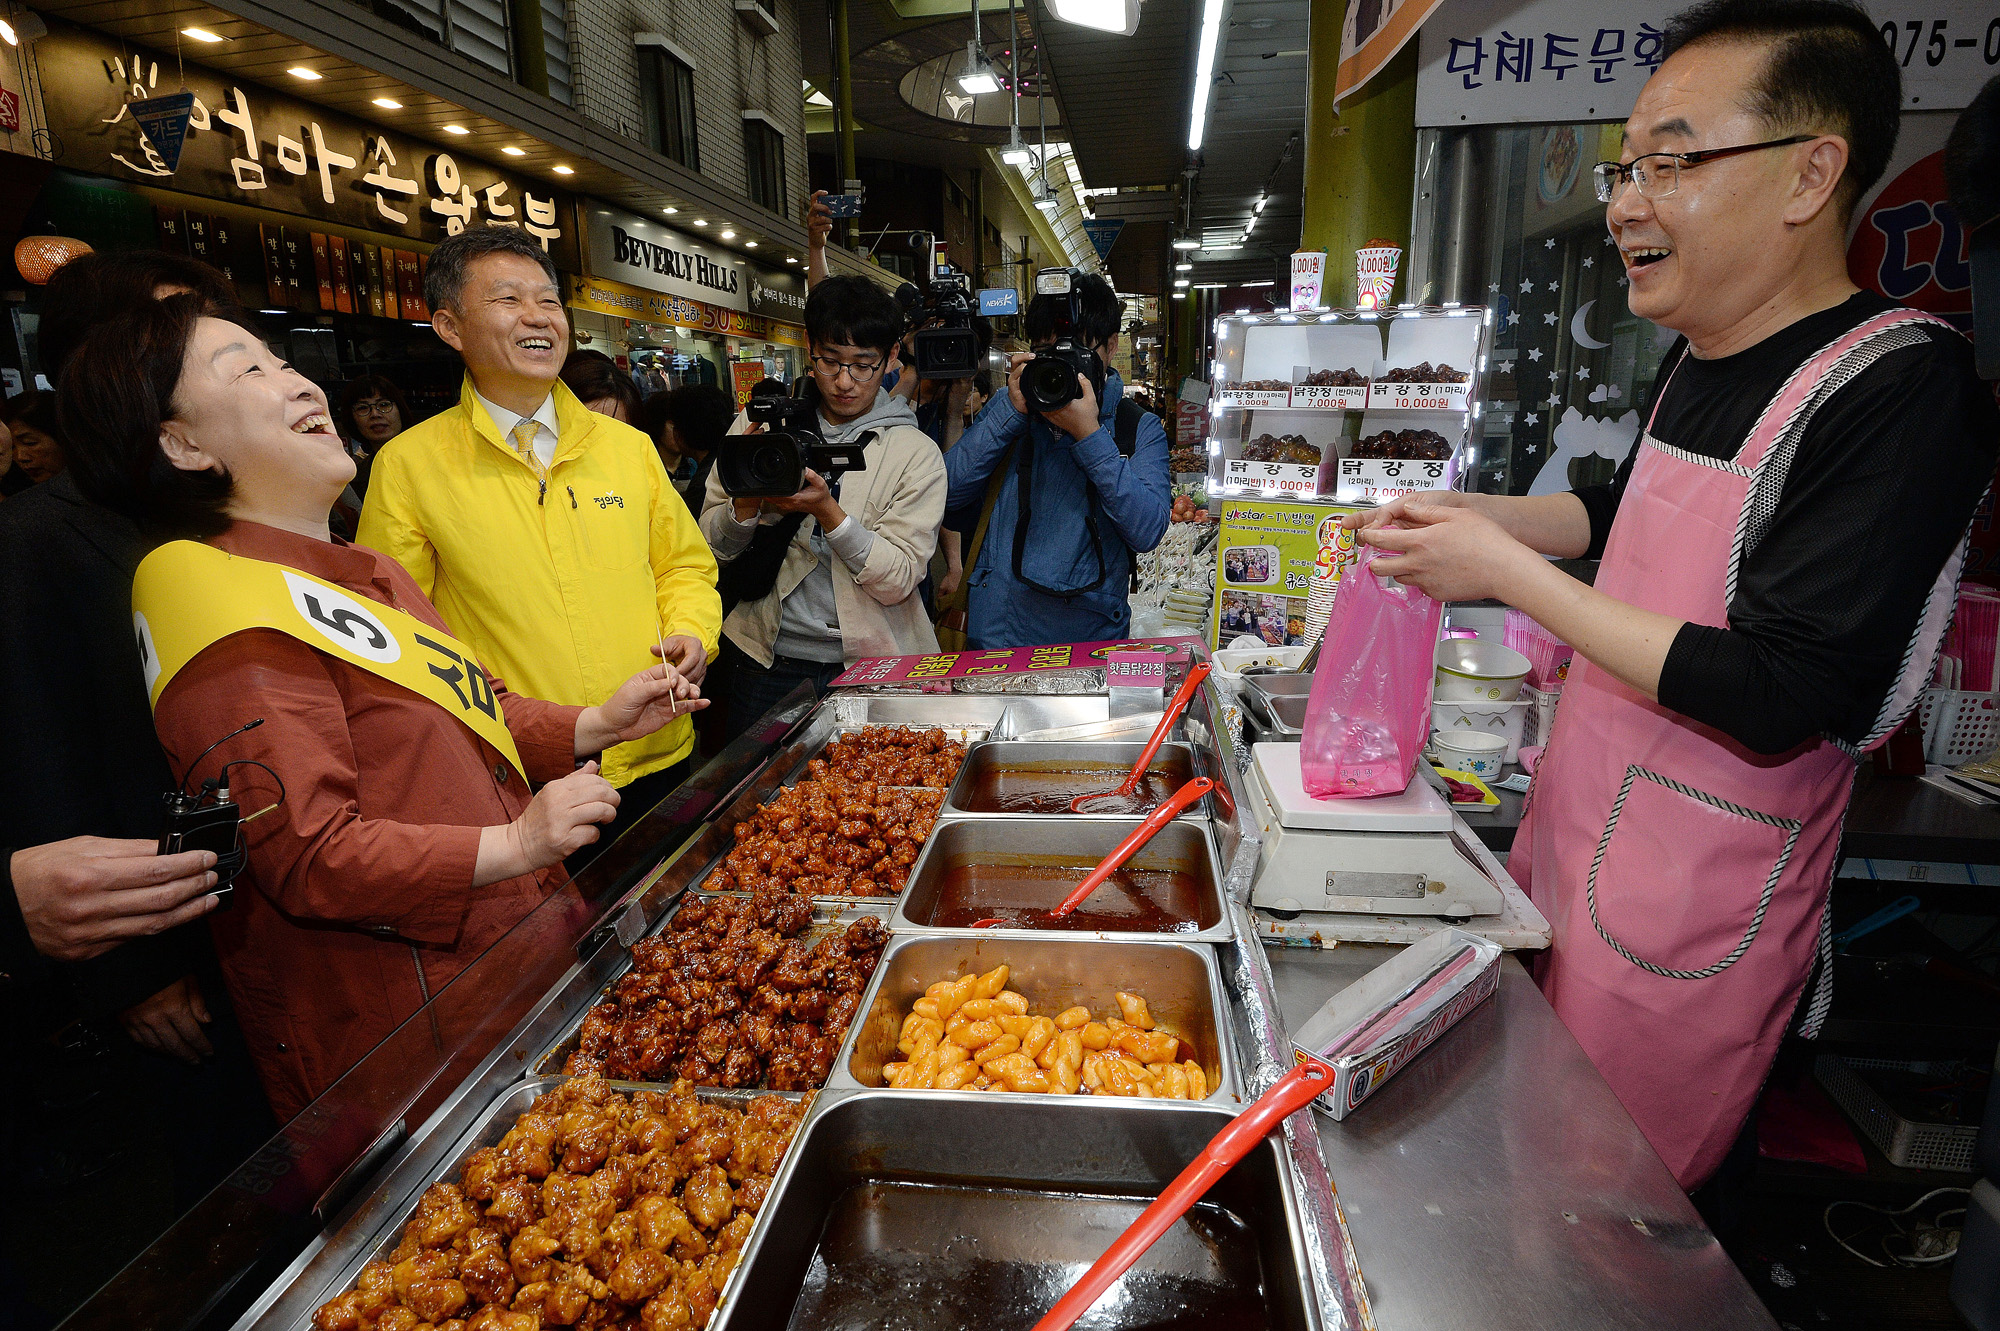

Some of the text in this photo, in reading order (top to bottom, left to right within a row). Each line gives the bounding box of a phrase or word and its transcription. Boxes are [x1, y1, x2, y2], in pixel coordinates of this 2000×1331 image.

[151, 118, 181, 139] 카드
[191, 221, 206, 254] 냉면
[1093, 231, 1112, 242] 카드
[267, 238, 282, 286] 칼국수
[286, 241, 298, 287] 만두피
[399, 259, 417, 273] 국내산
[612, 225, 739, 295] BEVERLY HILLS
[1361, 255, 1390, 275] 4,000원
[334, 248, 347, 294] 청국장
[353, 252, 366, 295] 된장
[368, 251, 381, 310] 도토리묵
[384, 259, 394, 301] 순두부
[406, 298, 420, 310] 두부
[649, 295, 701, 323] 신상품입하
[736, 314, 766, 334] SALE
[1222, 391, 1254, 399] 닭강정
[1294, 386, 1364, 397] 닭강정 (반마리)
[1435, 386, 1467, 395] (1마리)
[1307, 399, 1347, 408] 7,000원
[1394, 398, 1449, 409] 10,000원
[1262, 479, 1315, 493] 13,000원
[1348, 477, 1374, 486] (2마리)
[593, 496, 624, 509] 정의당
[1275, 512, 1315, 526] TV방영
[303, 592, 387, 649] 5
[1109, 662, 1163, 676] 핫콤닭강정
[1452, 989, 1478, 1018] FOIL
